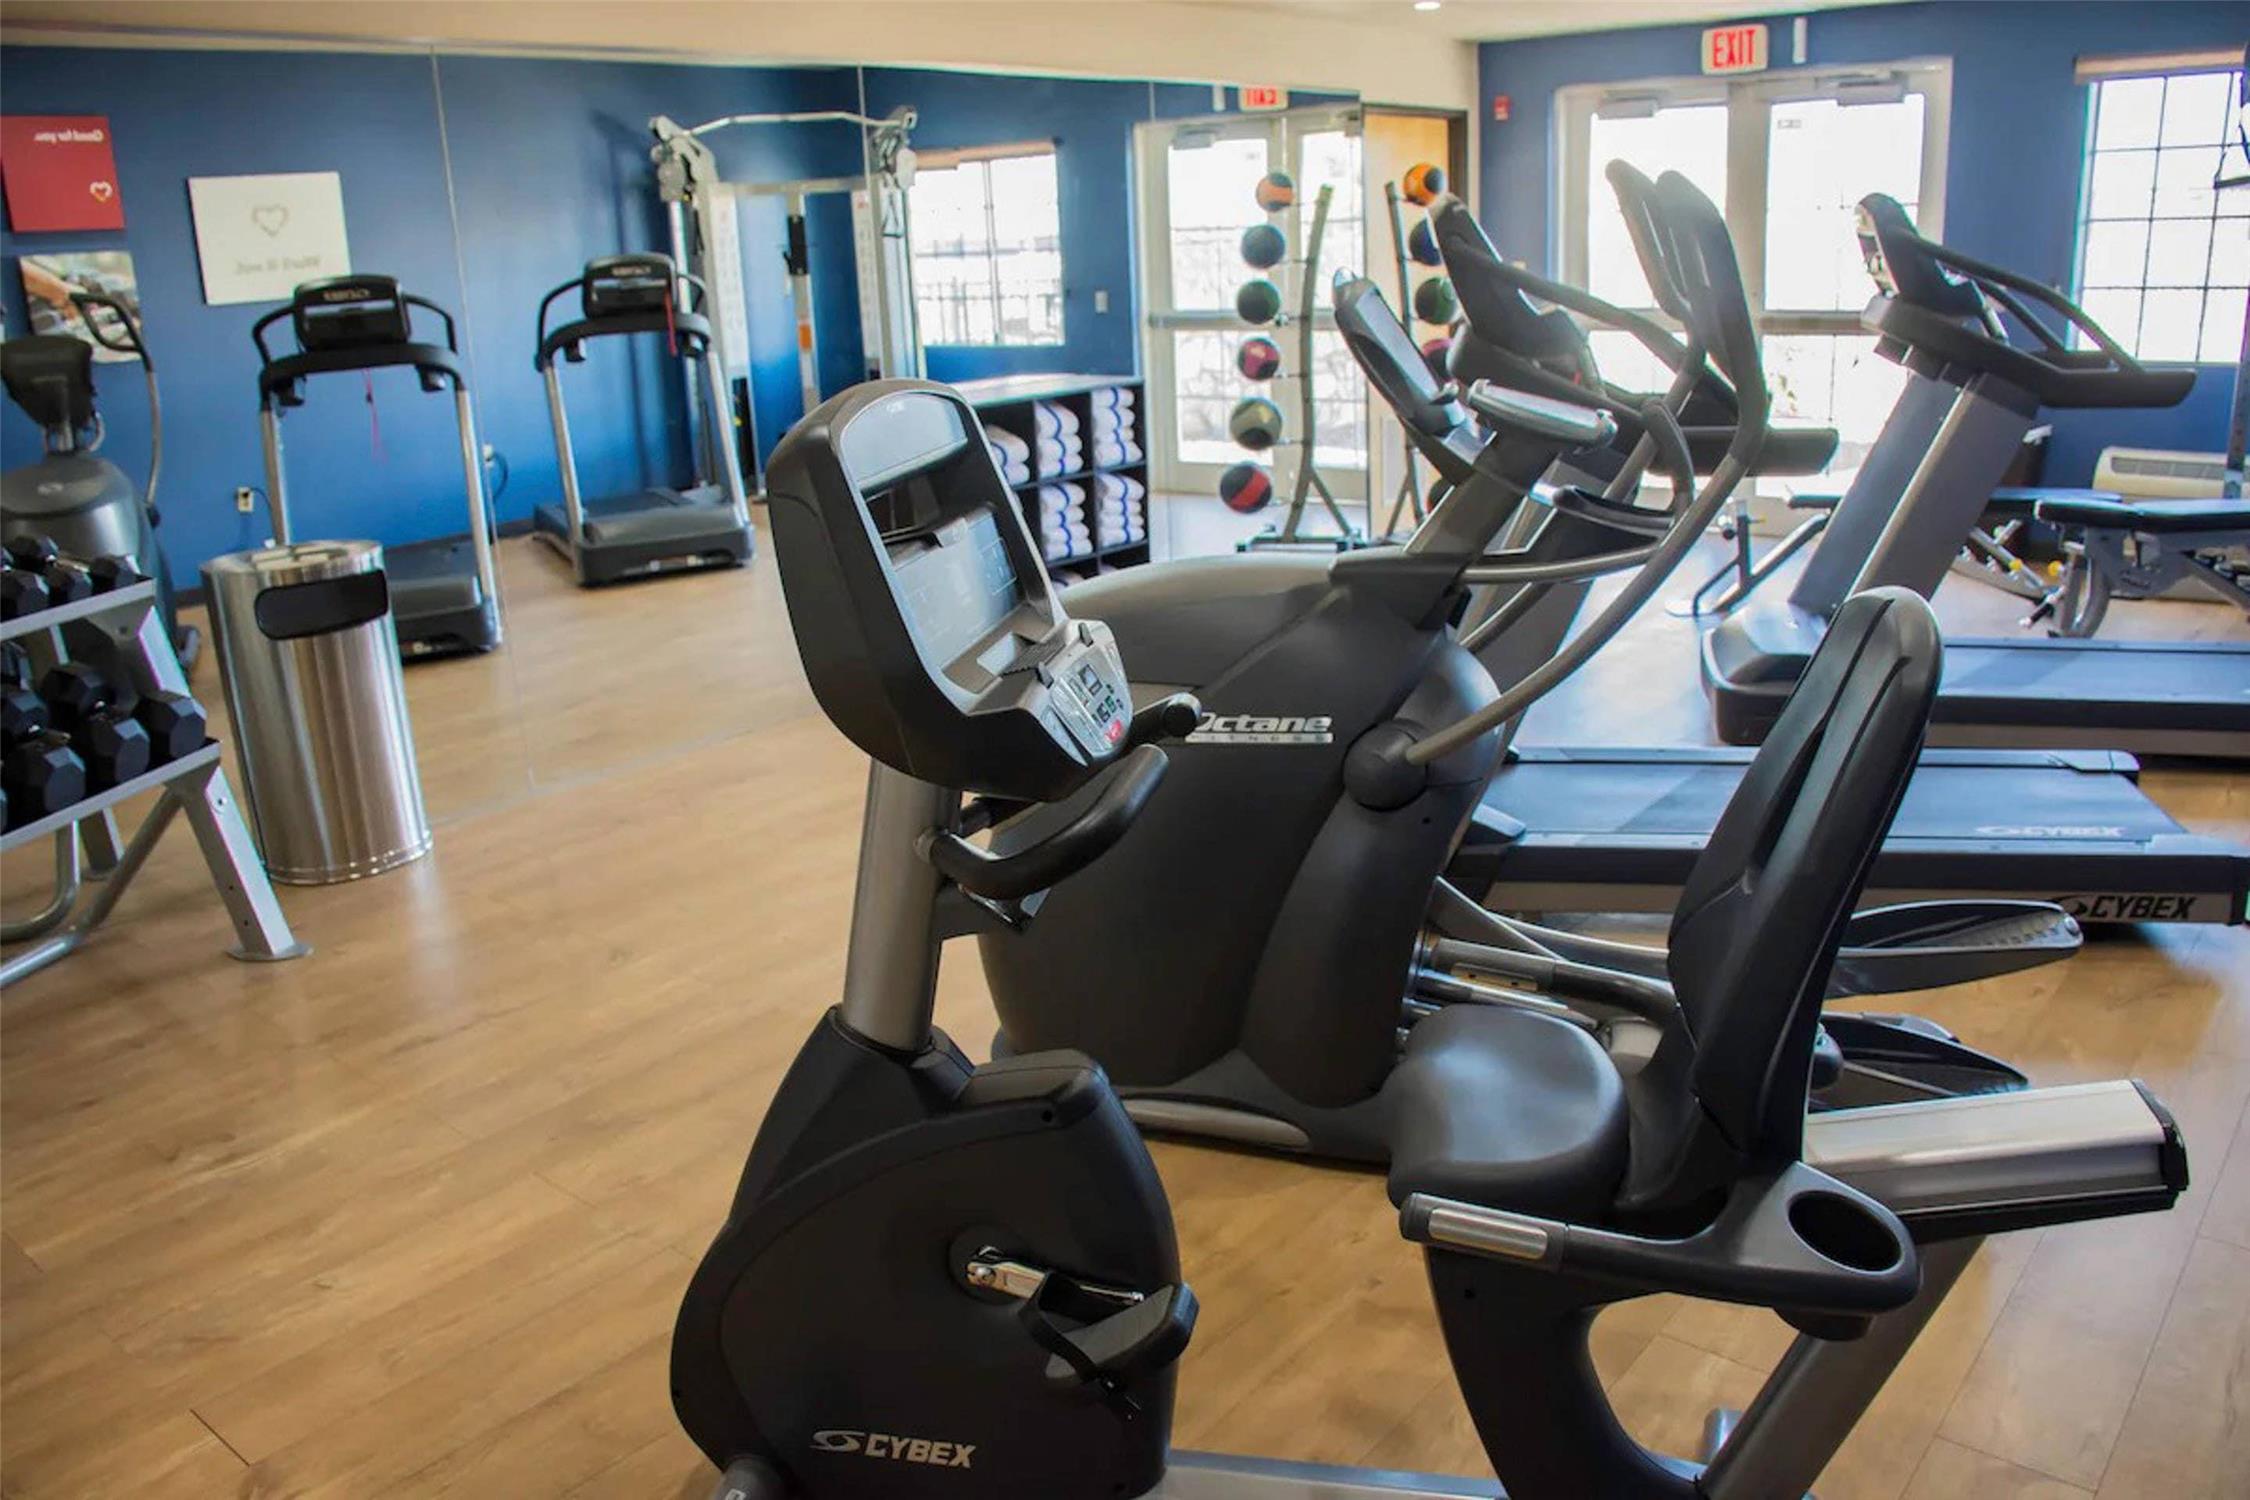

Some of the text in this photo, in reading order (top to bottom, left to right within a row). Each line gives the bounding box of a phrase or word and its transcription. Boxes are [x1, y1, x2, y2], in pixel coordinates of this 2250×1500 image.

[1712, 29, 1756, 68] EXIT
[2090, 895, 2196, 919] CYBEX
[864, 1433, 977, 1469] CYBEX
